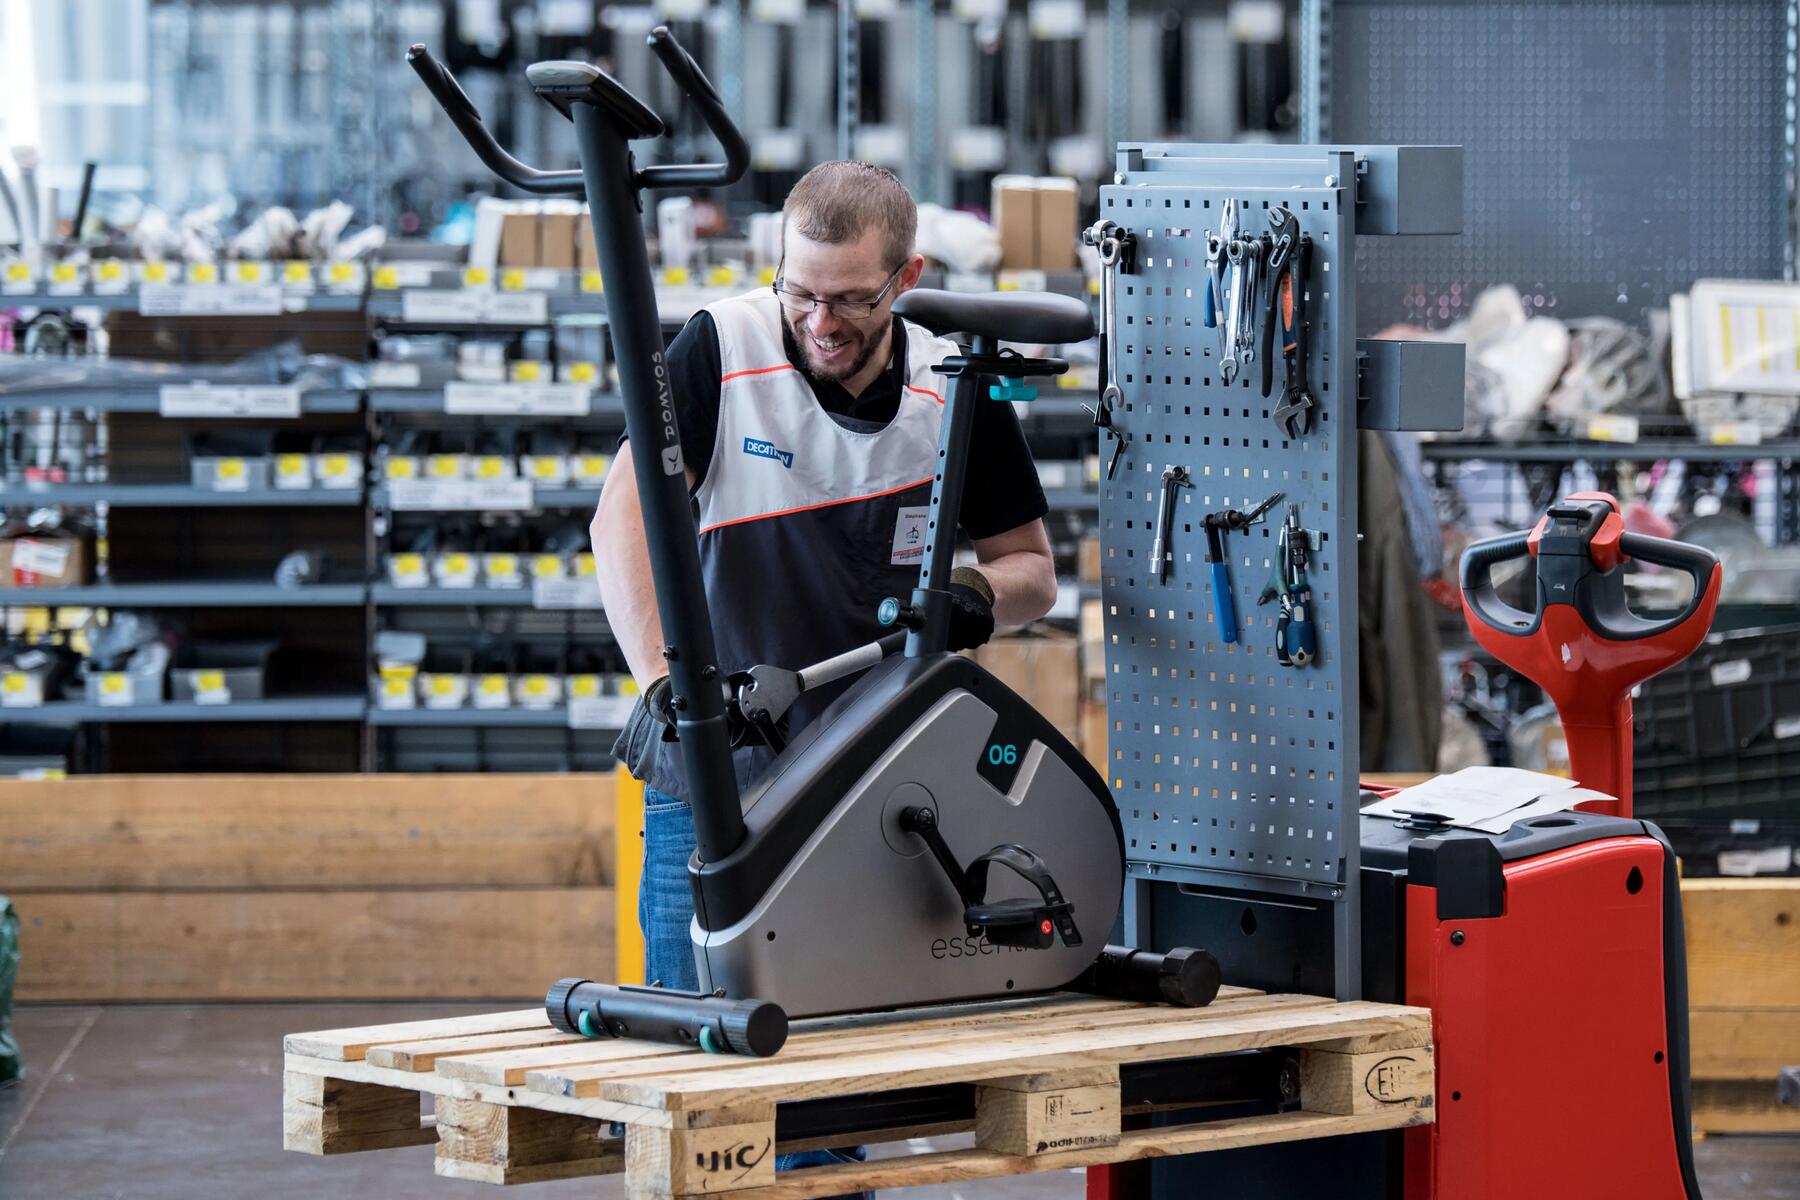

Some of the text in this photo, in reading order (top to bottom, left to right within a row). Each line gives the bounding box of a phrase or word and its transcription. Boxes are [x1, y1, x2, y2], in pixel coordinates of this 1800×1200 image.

[652, 351, 675, 441] DOMYOS
[747, 441, 790, 466] DECATN
[989, 744, 1017, 765] 06
